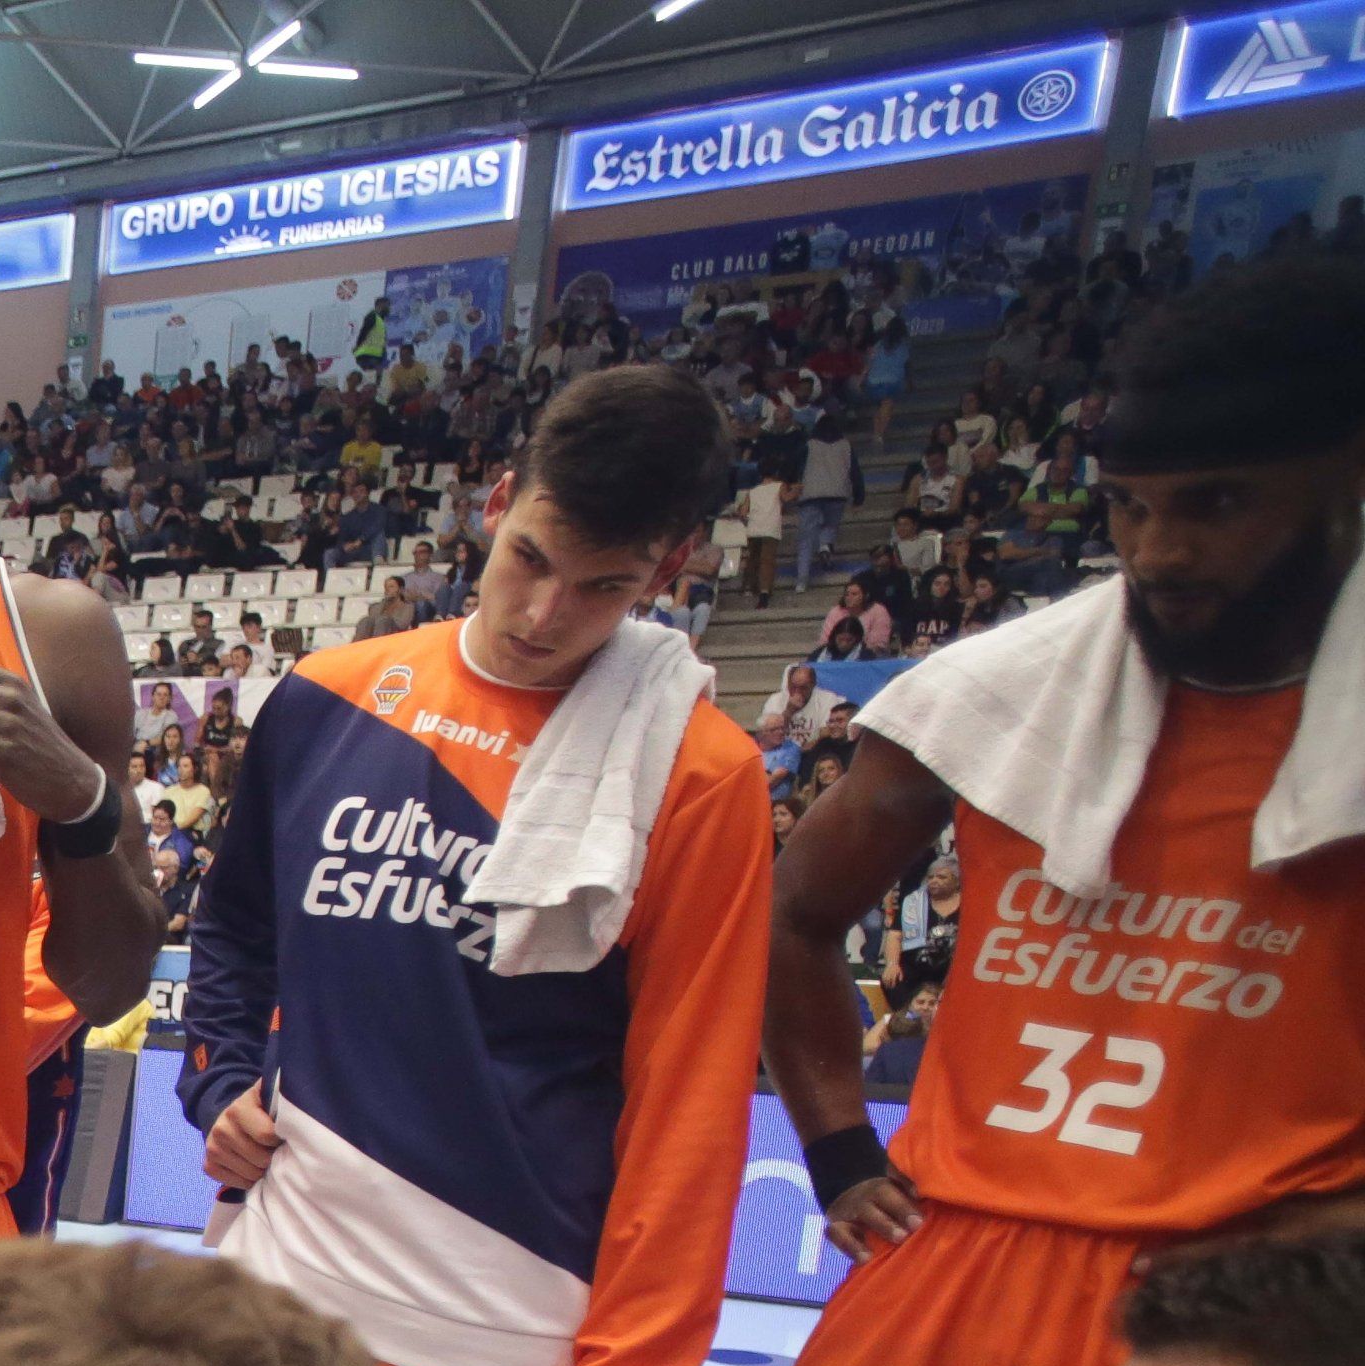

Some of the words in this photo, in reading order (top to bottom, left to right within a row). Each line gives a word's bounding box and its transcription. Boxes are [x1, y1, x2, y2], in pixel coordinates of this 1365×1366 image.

[584, 121, 786, 193] Estrella
[797, 82, 1000, 158] Galicia
[121, 191, 235, 240] GRUPO
[248, 177, 325, 221] LUIS
[339, 150, 501, 207] IGLESIAS
[278, 213, 385, 246] FUNERARIAS
[303, 857, 496, 962] Esfuerz
[1235, 920, 1305, 956] del
[973, 926, 1284, 1019] Esfuerzo
[985, 1022, 1166, 1156] 32
